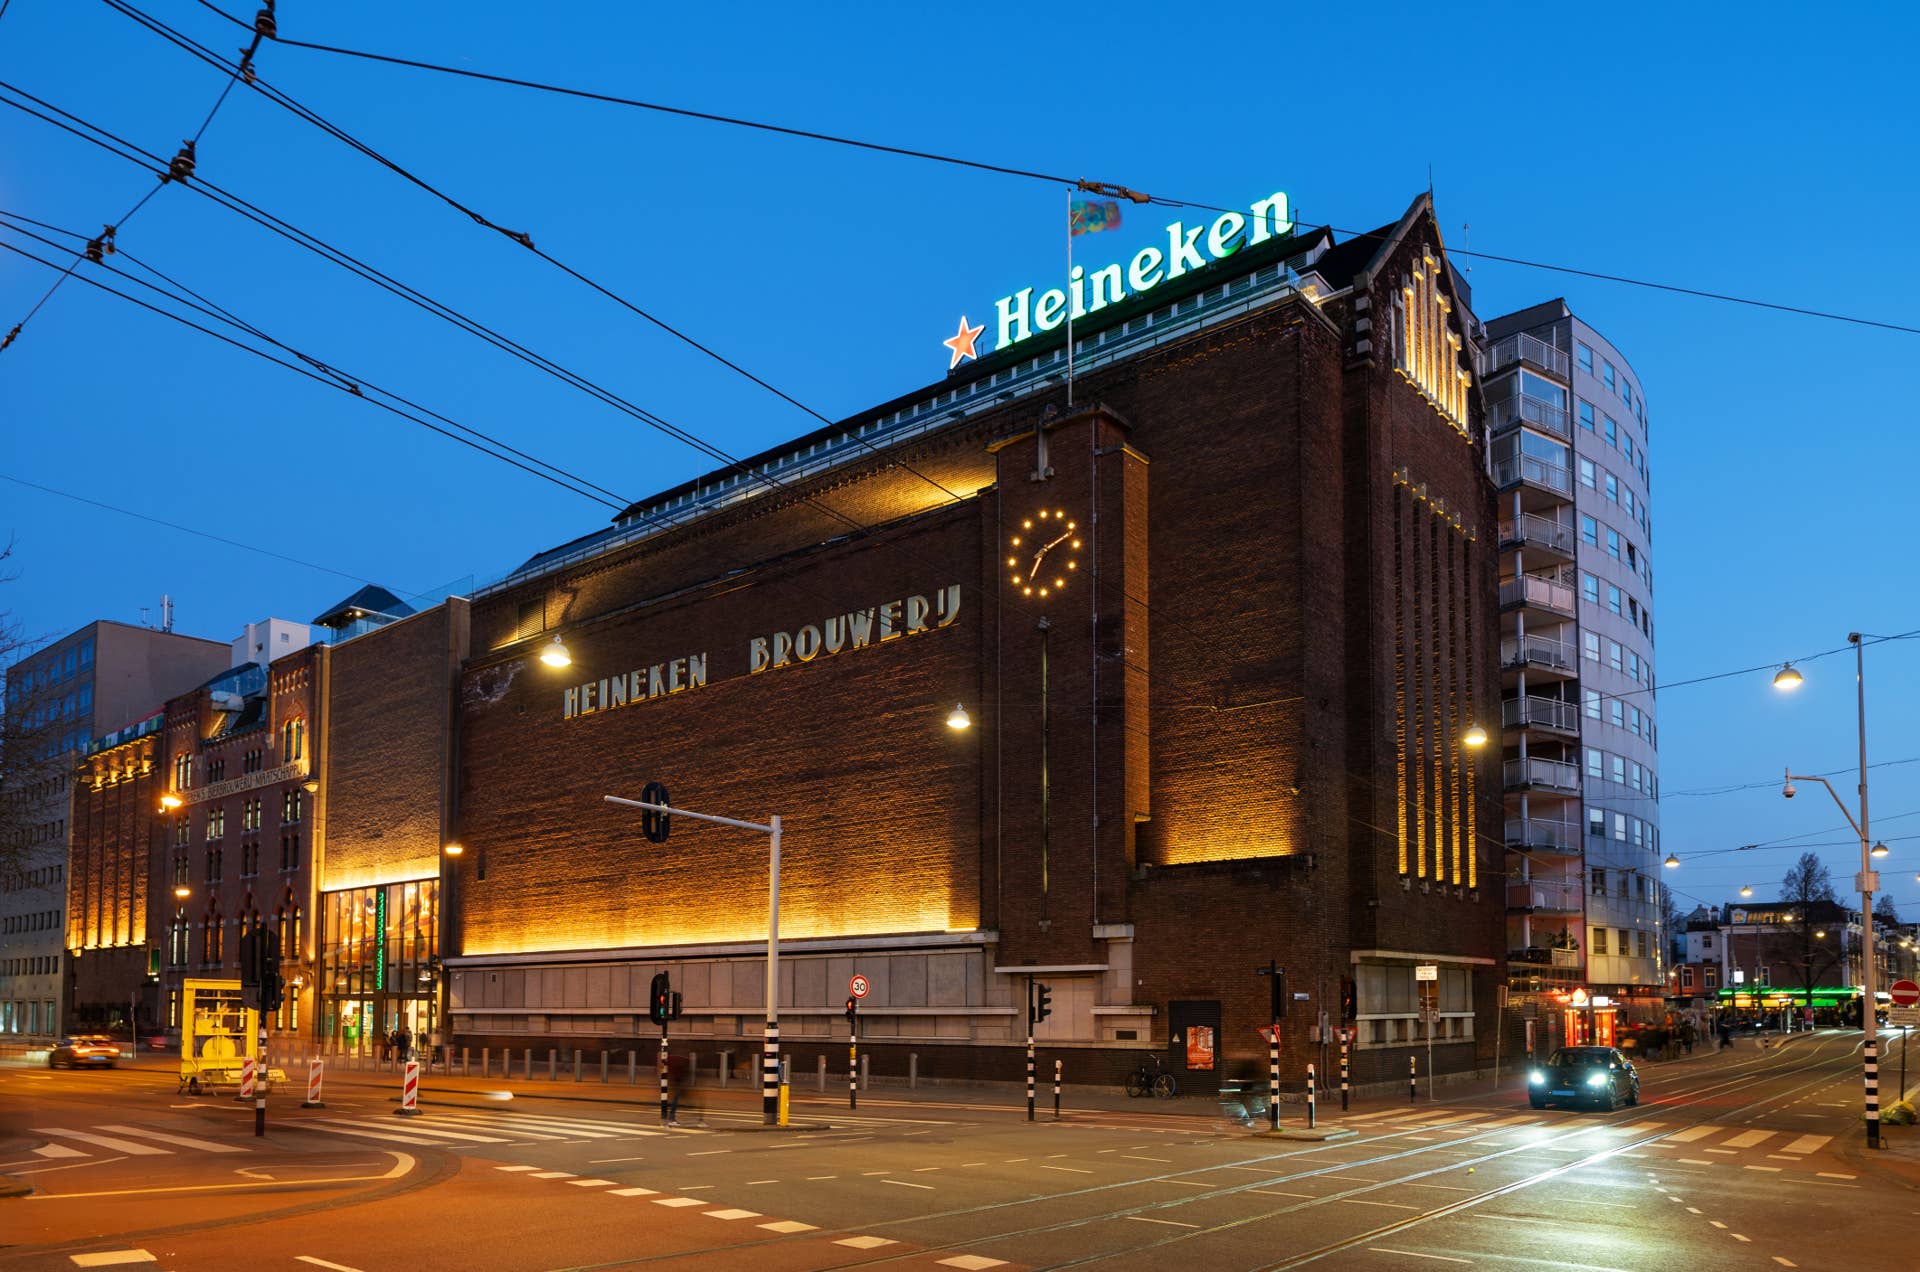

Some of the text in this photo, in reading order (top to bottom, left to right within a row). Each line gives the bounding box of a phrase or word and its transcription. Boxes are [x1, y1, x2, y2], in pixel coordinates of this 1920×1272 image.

[995, 191, 1293, 350] Heineken
[563, 652, 707, 719] HEINEKEN
[854, 982, 866, 991] 30
